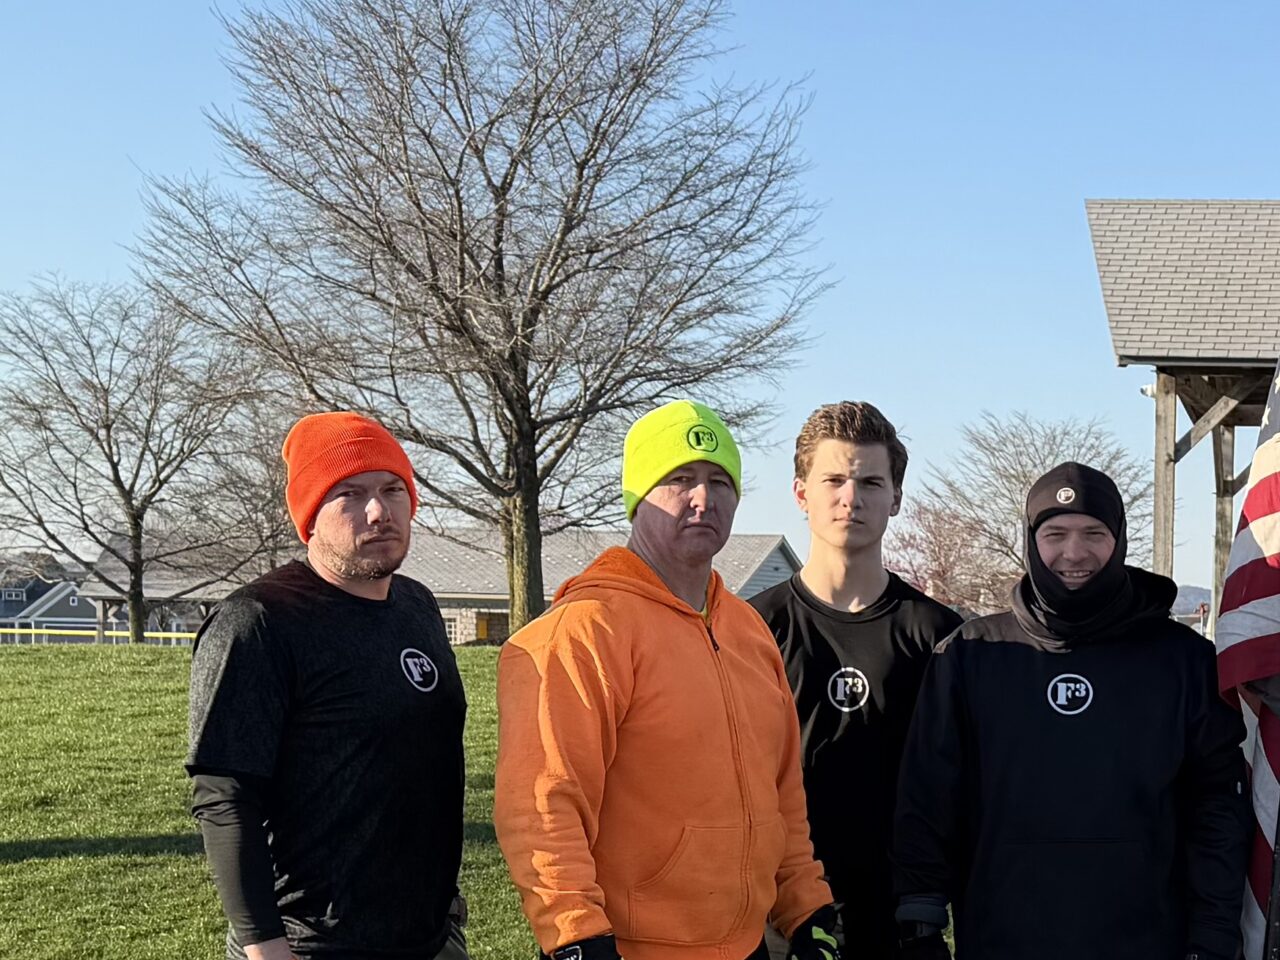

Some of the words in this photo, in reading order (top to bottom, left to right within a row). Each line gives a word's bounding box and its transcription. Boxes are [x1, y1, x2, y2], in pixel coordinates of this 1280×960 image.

[405, 657, 432, 682] F3
[836, 678, 863, 701] F3
[1055, 683, 1087, 705] F3
